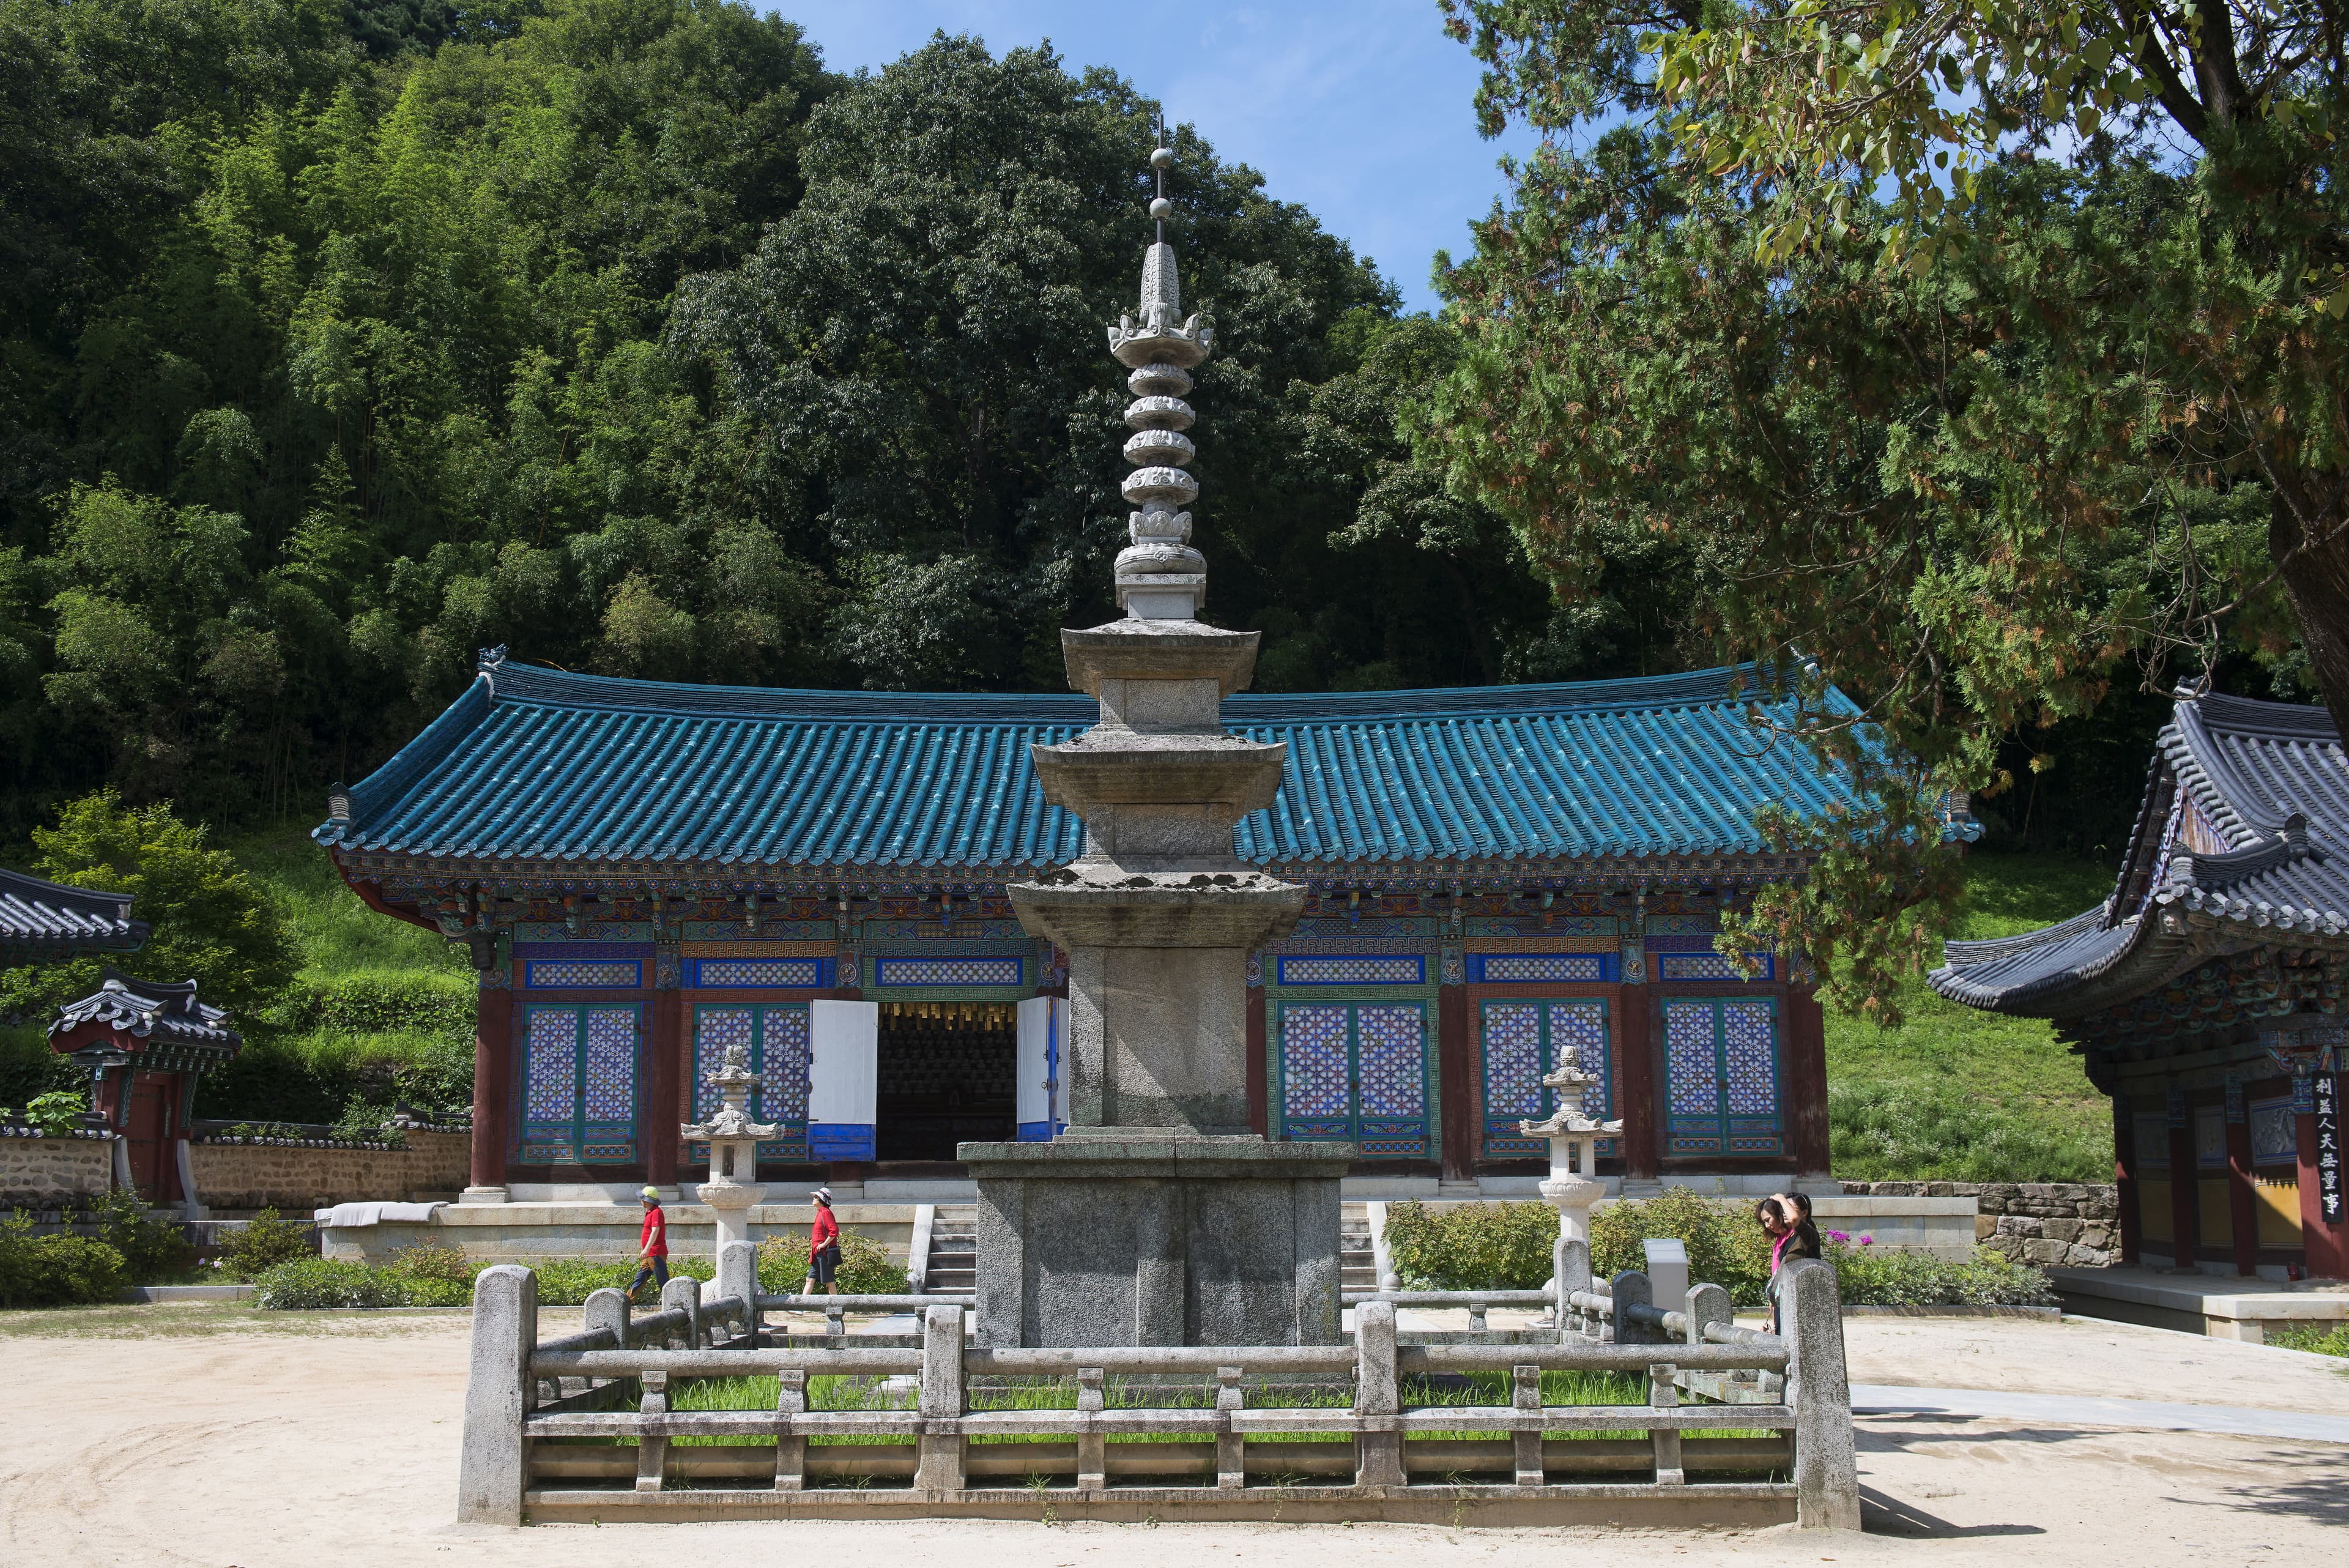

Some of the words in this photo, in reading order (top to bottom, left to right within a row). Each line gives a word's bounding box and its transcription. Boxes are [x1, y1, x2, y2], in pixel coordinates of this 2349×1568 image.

[2315, 1077, 2339, 1214] 利益人天無量事
